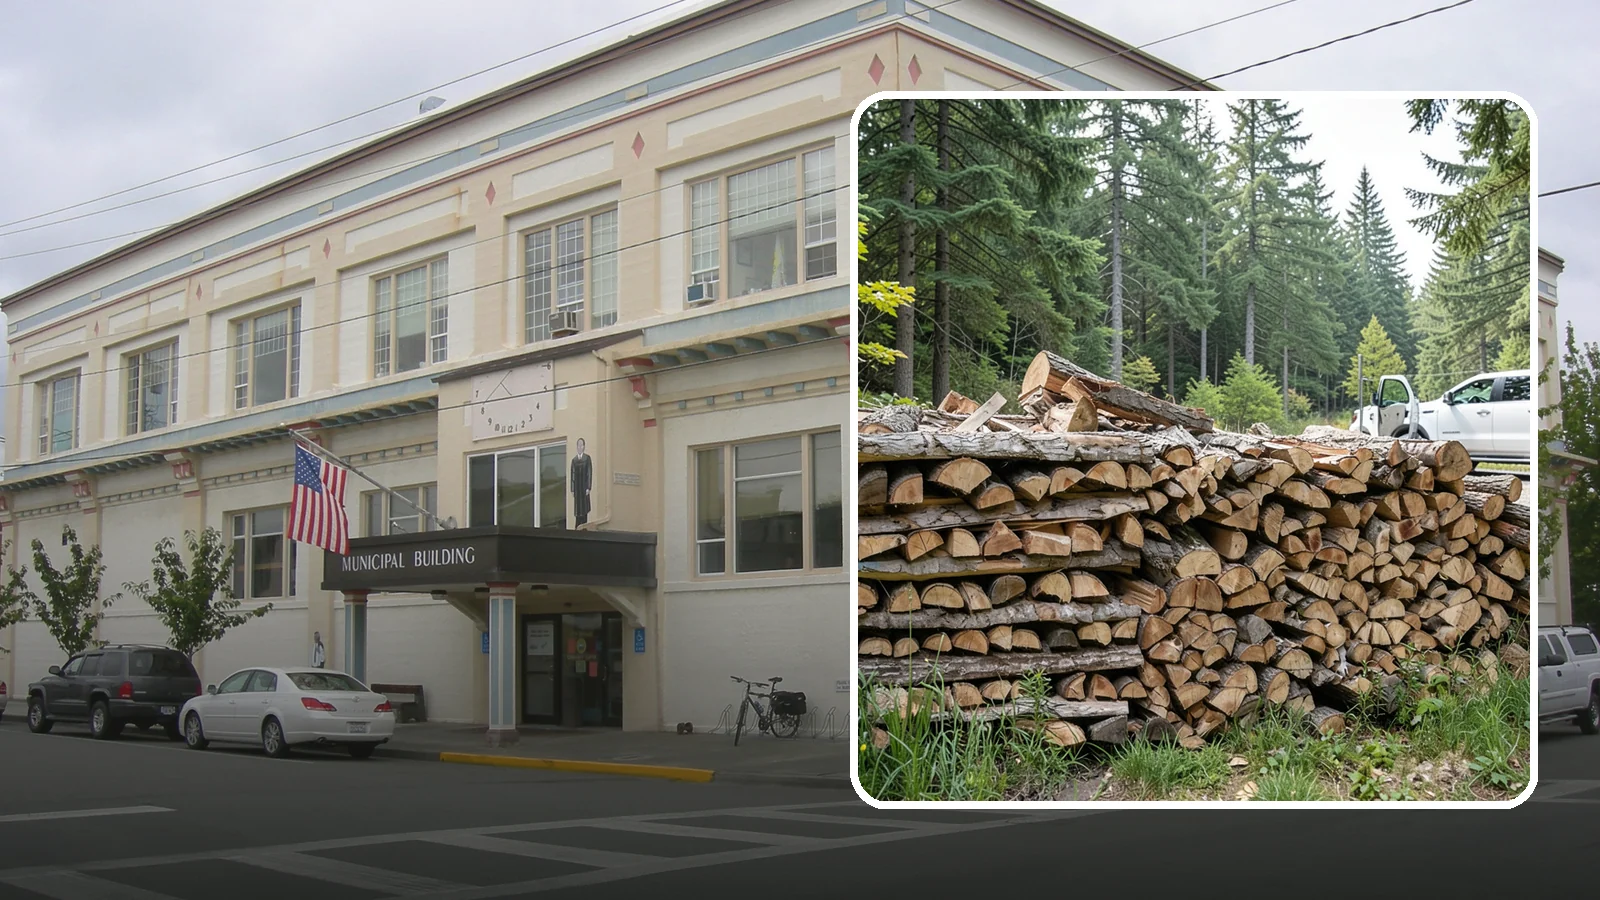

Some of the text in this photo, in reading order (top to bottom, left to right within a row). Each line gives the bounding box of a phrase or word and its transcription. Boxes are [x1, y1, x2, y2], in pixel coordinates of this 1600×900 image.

[475, 390, 479, 398] 7
[536, 402, 540, 410] 4
[481, 407, 485, 415] 8
[488, 418, 492, 426] 9
[529, 414, 533, 422] 3
[494, 423, 500, 432] 10
[501, 425, 506, 433] 11
[507, 425, 513, 433] 12
[521, 420, 525, 428] 2
[342, 546, 475, 571] MUNICIPAL BUILDING
